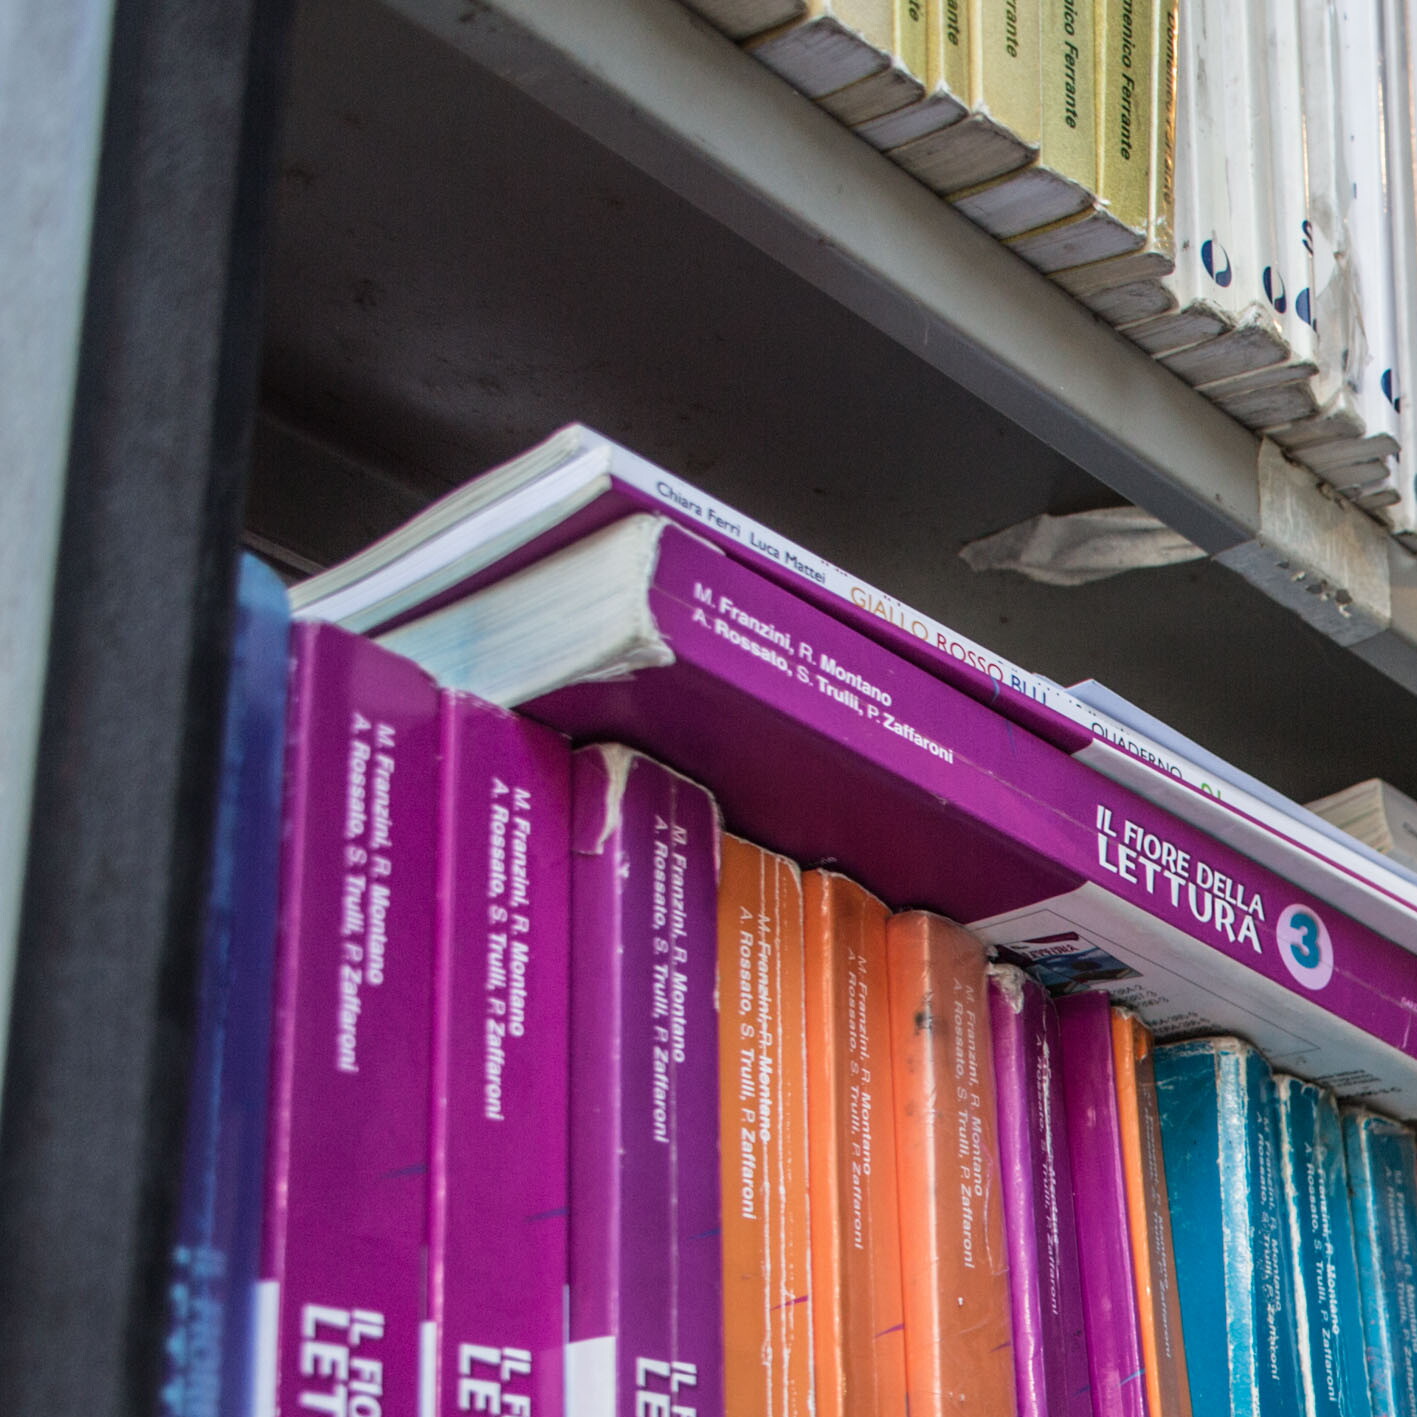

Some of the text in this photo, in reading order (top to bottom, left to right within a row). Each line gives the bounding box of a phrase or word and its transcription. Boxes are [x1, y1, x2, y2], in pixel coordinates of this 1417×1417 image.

[1063, 41, 1079, 129] Ferrante
[1120, 73, 1135, 160] Ferrante
[656, 481, 826, 584] Chiara Ferri Luca Mattei
[694, 583, 892, 707] M. Franzini, R. Montano
[850, 586, 929, 642] GIALLO
[936, 632, 1003, 682] ROSSO
[692, 608, 954, 764] A. Rossato, S. Trulli, P. Zaffaroni
[508, 788, 531, 1037] M. Franzini, R. Montano
[1096, 804, 1266, 922] IL FIORE DELLA
[1097, 833, 1263, 954] LETTURA
[484, 778, 509, 1121] A. Rossato, S. Trulli, P. Zaffaroni
[1289, 912, 1320, 969] 3
[739, 907, 757, 1220] A. Rossato, S. Trulli, P. Zaffaroni
[348, 1309, 385, 1346] IL
[500, 1347, 532, 1382] IL
[670, 1361, 698, 1393] IL
